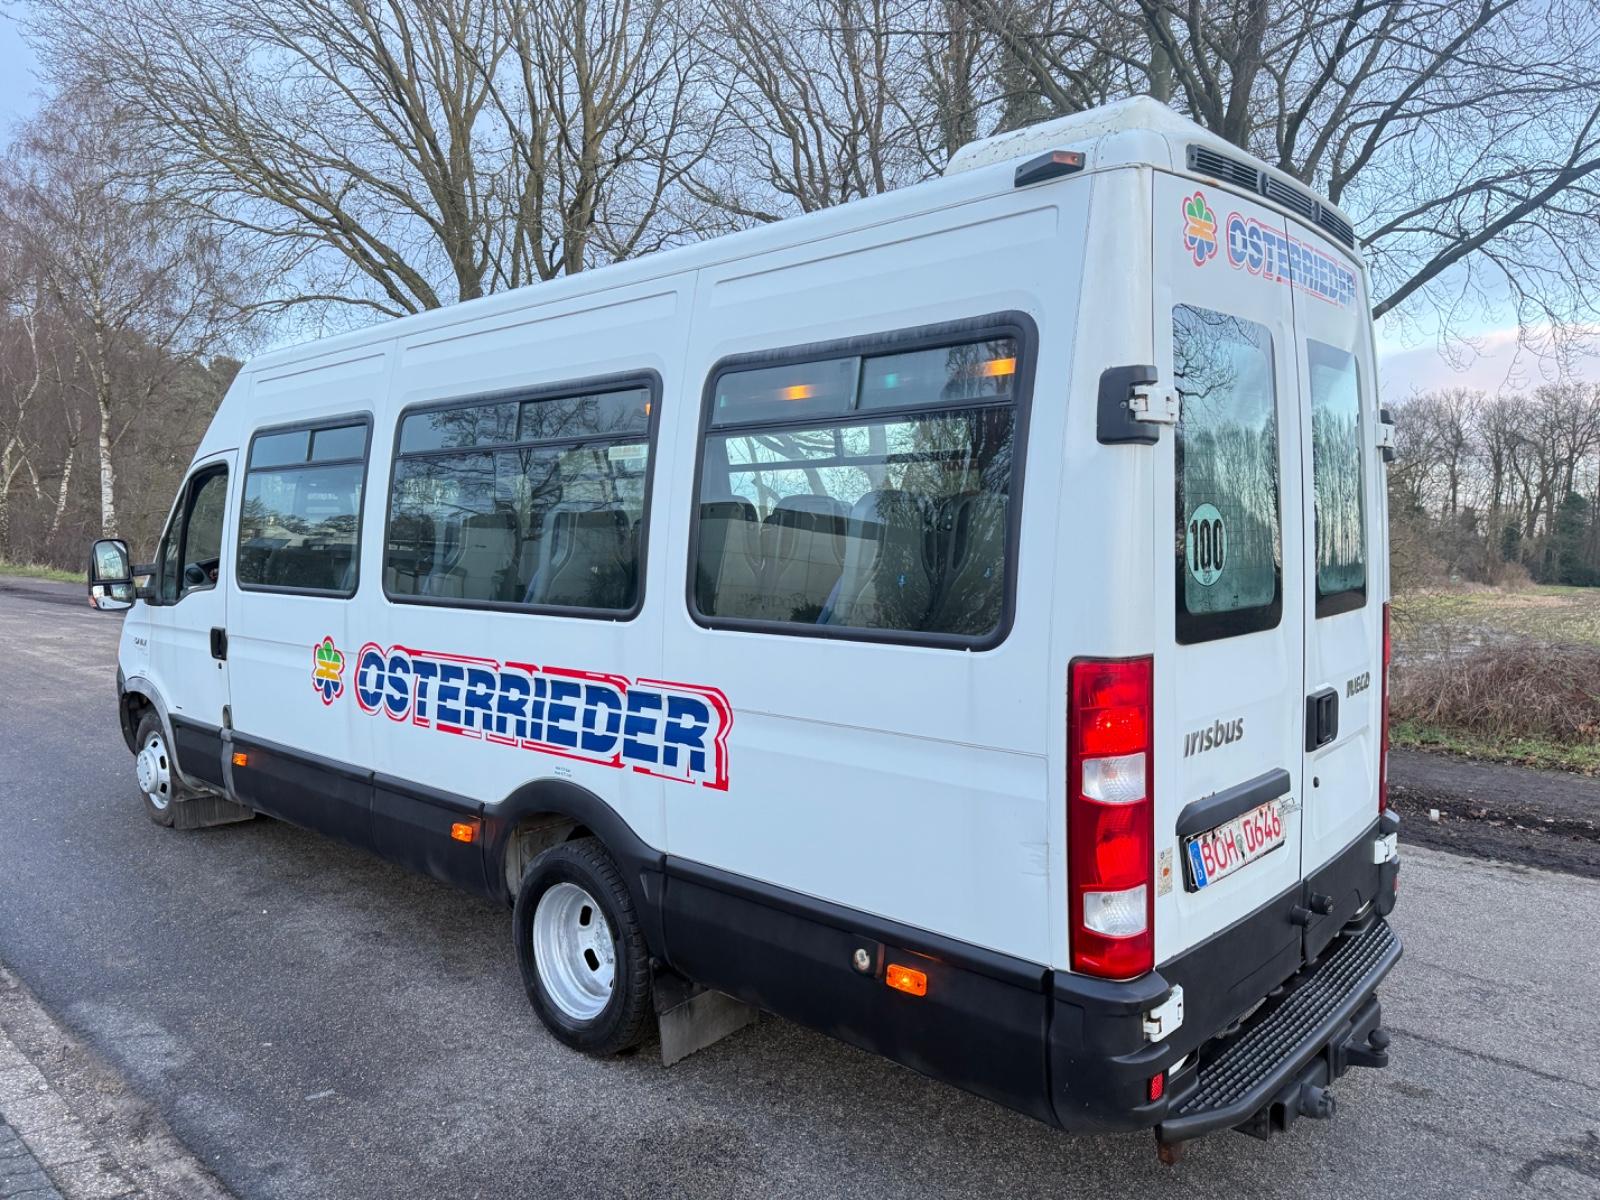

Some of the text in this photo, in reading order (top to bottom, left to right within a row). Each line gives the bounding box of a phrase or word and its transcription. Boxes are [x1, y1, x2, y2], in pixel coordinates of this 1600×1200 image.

[1229, 218, 1356, 305] OSTERRIEDER
[1190, 518, 1224, 571] 100
[359, 650, 711, 773] OSTERRIEDER
[1346, 671, 1370, 698] IVECO
[1201, 829, 1239, 876] BOH
[1243, 807, 1281, 852] D646
